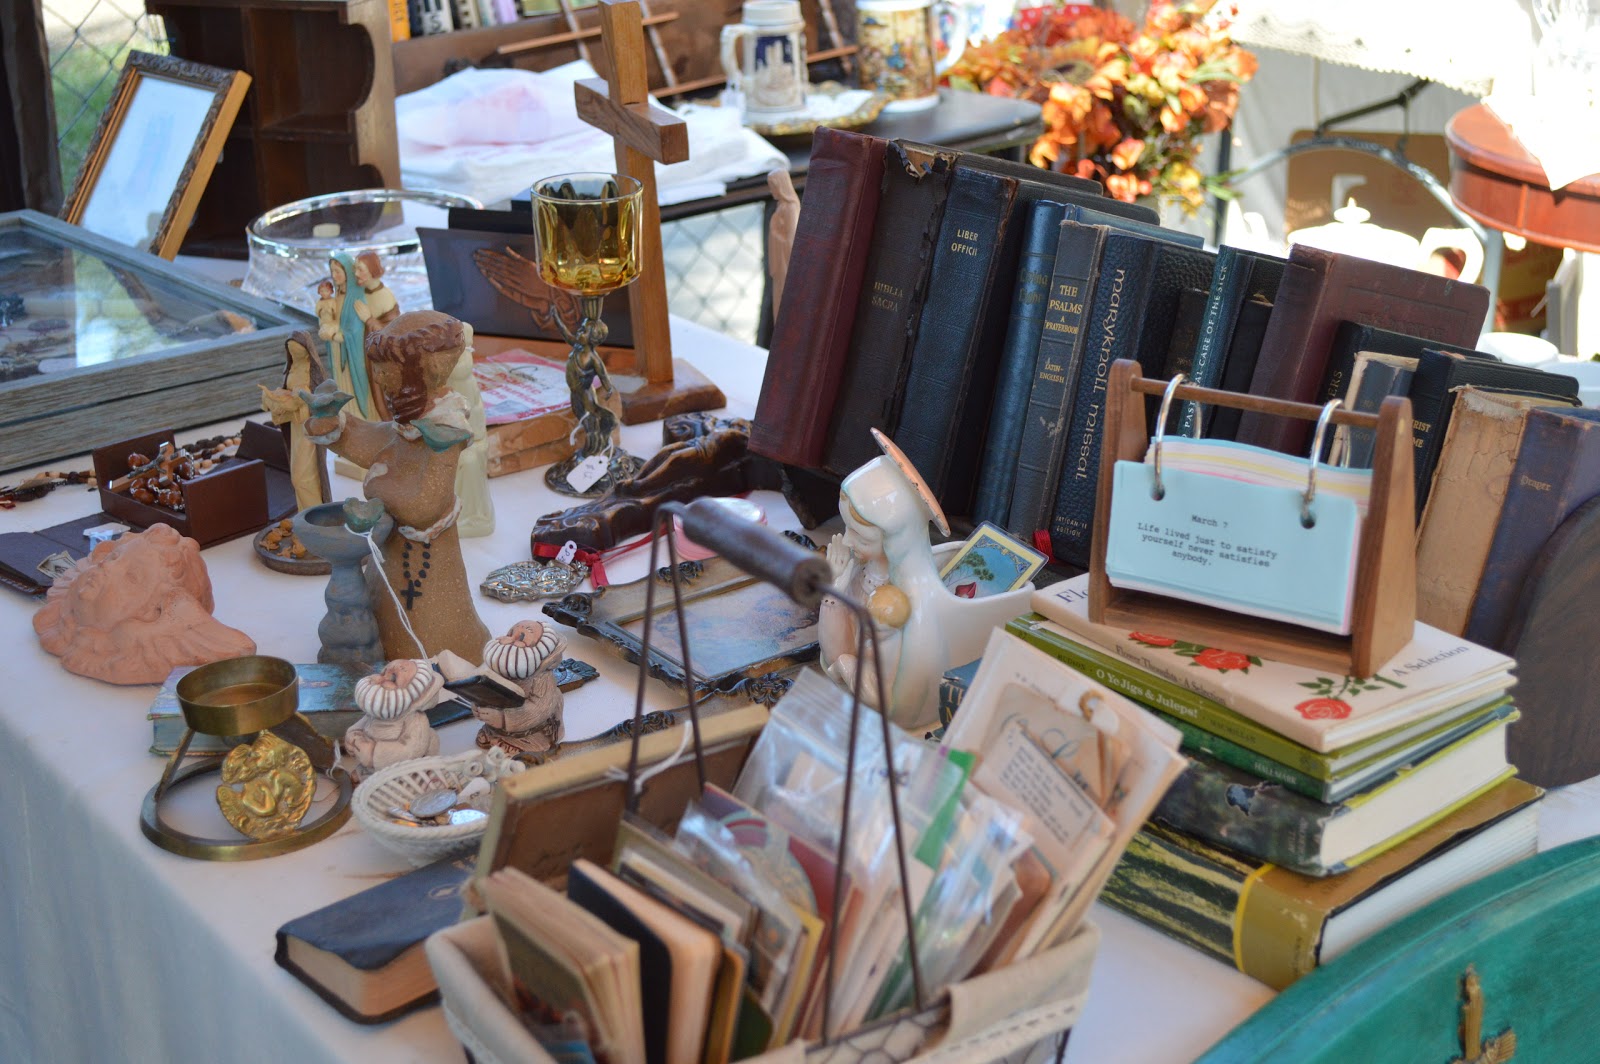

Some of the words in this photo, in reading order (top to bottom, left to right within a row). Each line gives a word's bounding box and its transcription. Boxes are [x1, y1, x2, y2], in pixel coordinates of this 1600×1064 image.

[956, 228, 979, 242] LIBER
[1217, 265, 1228, 293] SICK
[1059, 284, 1079, 298] THE
[871, 295, 899, 313] SACRA
[1049, 299, 1083, 315] PSALMS
[1210, 295, 1221, 316] THE
[1060, 315, 1066, 323] A
[1206, 319, 1216, 335] OF
[1198, 337, 1211, 367] CARE
[1039, 371, 1065, 384] ENGLISH
[1184, 370, 1203, 428] PASTAL
[1412, 419, 1432, 433] RIST
[1191, 514, 1218, 527] March
[1137, 522, 1160, 534] Life
[1165, 528, 1190, 540] lived
[1195, 535, 1215, 547] just
[1220, 541, 1232, 550] to
[1236, 544, 1278, 560] satisfy
[1142, 533, 1184, 549] yourself
[1188, 544, 1214, 556] never
[1219, 551, 1270, 568] satisfies
[1172, 550, 1212, 566] anybody.
[1403, 646, 1470, 672] Selection
[1095, 668, 1106, 679] O
[1107, 672, 1121, 687] Ye
[1119, 678, 1143, 696] Jigs
[1144, 689, 1155, 701] &
[1156, 692, 1199, 719] Juleps!
